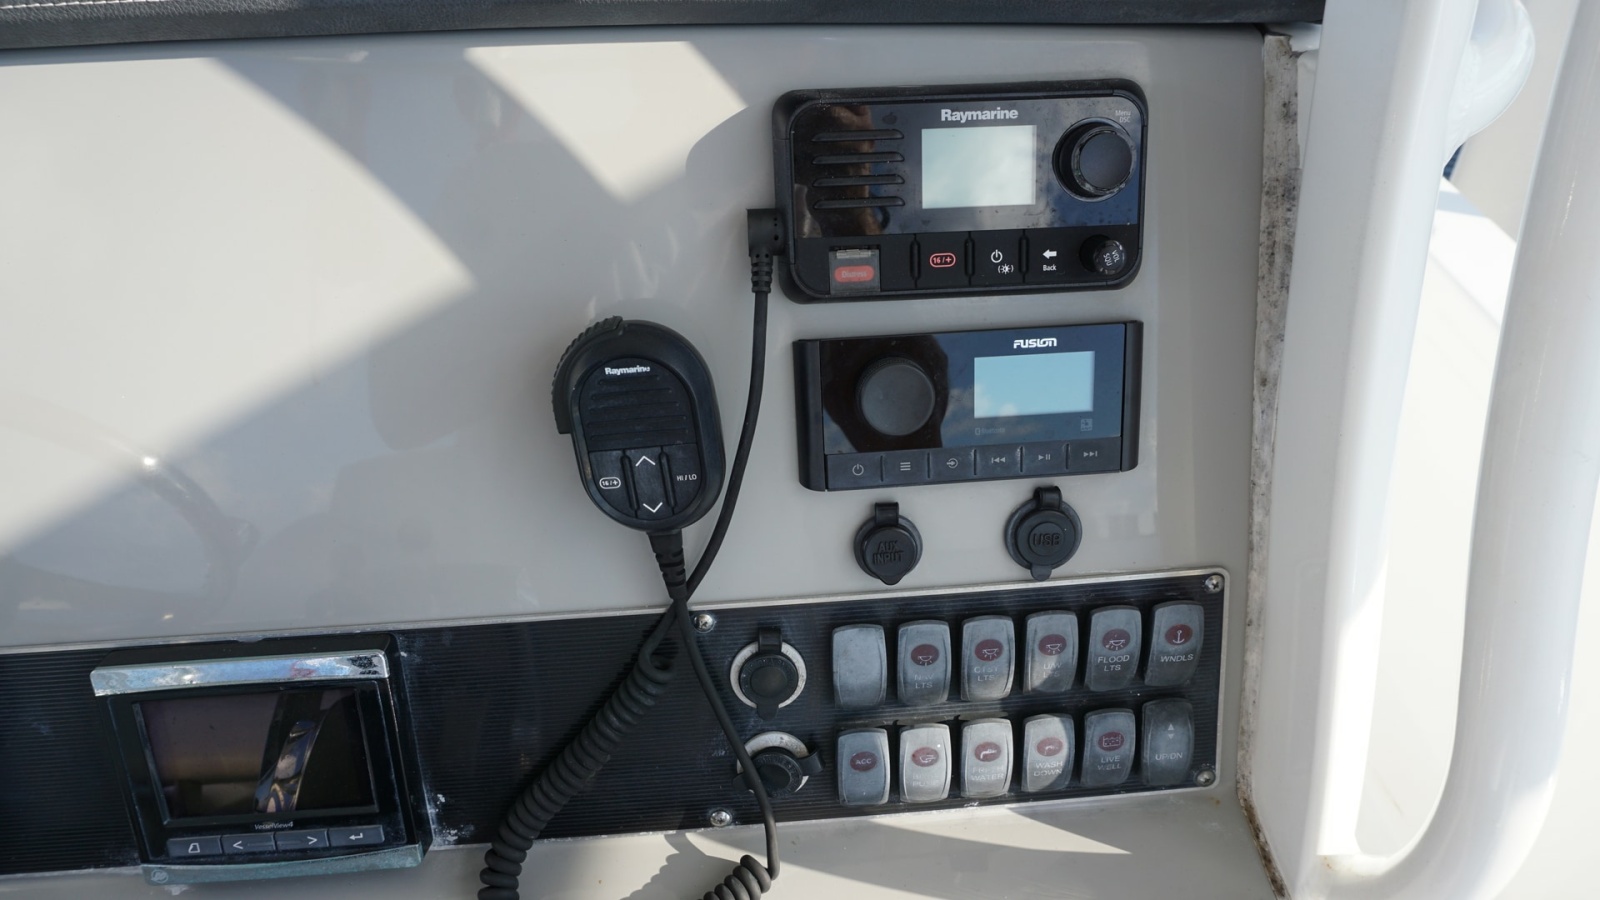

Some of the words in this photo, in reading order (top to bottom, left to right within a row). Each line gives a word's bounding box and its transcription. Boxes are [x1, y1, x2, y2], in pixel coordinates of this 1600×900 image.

[941, 107, 1019, 123] Raymarine
[1112, 249, 1120, 263] VOL
[1013, 337, 1058, 349] FUSION
[1032, 532, 1062, 547] USB
[878, 540, 899, 552] AUX
[872, 551, 905, 565] INPUT
[1097, 654, 1130, 664] FLOOD
[1160, 653, 1194, 663] WNDLS
[1103, 664, 1121, 672] LTS
[977, 674, 995, 682] LTS
[1101, 755, 1121, 763] LIVE
[1035, 760, 1063, 769] WASH
[1097, 763, 1122, 771] WELL
[970, 773, 1005, 781] WATER
[1033, 768, 1063, 777] DOWN
